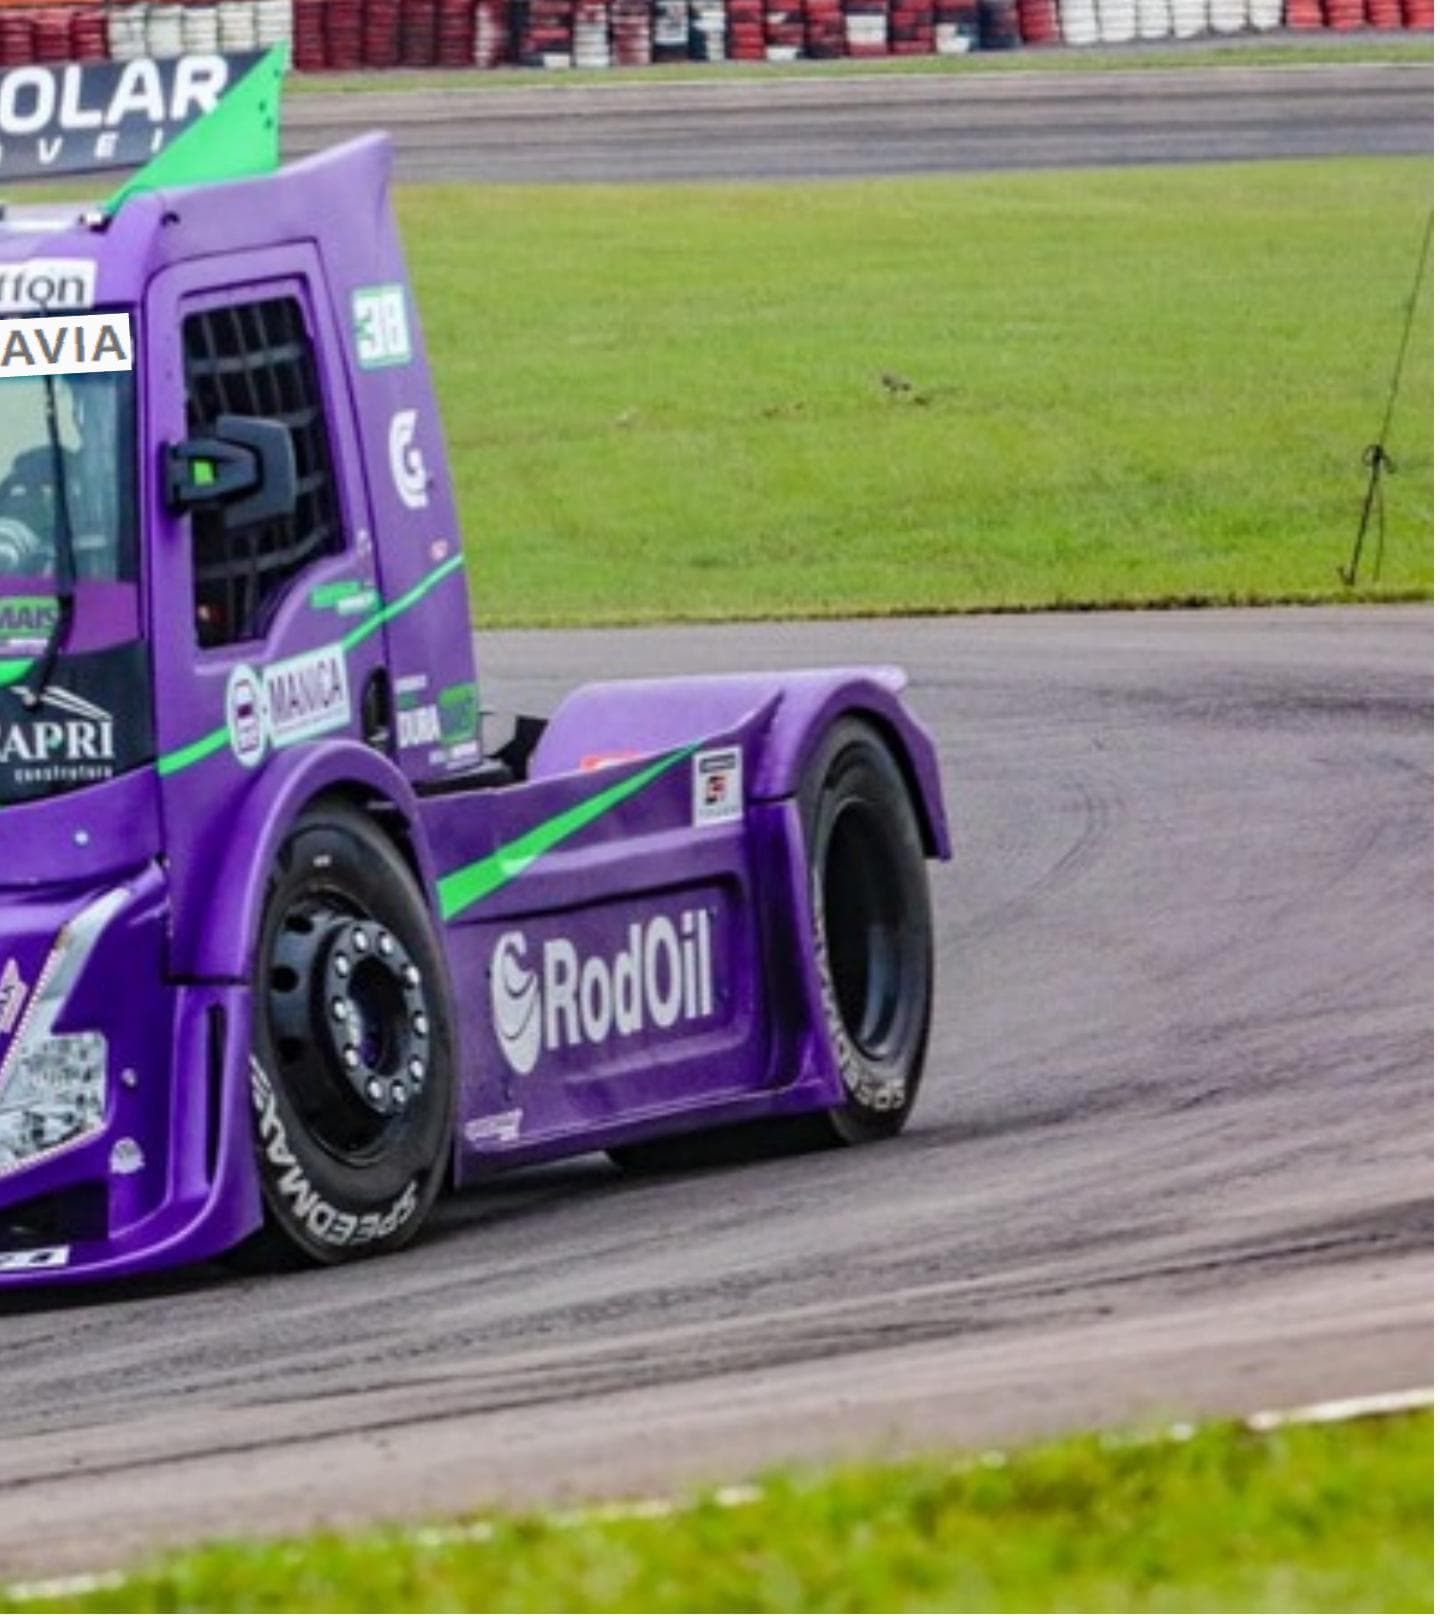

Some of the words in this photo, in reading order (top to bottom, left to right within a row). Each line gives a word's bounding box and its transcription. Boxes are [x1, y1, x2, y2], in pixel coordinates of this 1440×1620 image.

[353, 293, 409, 361] 38
[543, 909, 714, 1051] RodOil
[255, 1075, 419, 1246] SPEEDMAX
